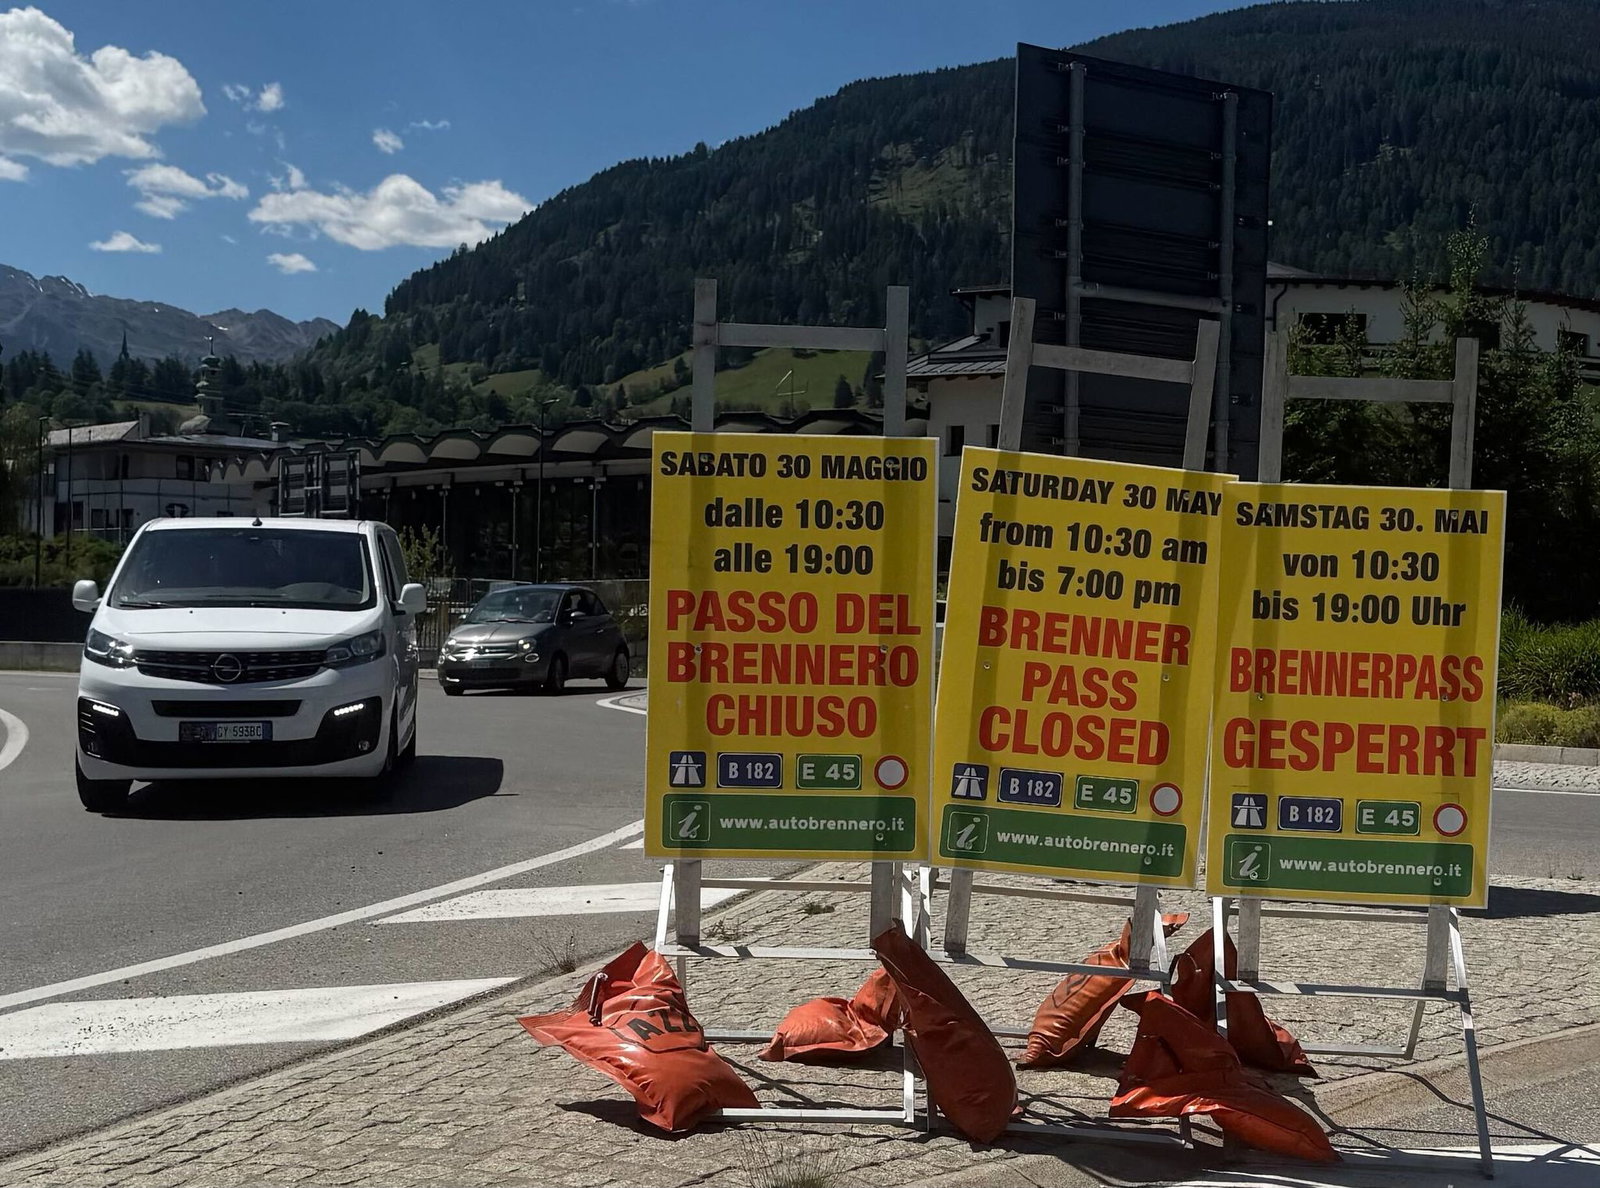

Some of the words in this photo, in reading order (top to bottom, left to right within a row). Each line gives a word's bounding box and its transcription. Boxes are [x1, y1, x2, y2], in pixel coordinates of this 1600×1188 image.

[661, 452, 766, 477] SABATO
[777, 455, 810, 478] 30
[822, 455, 927, 481] MAGGIO
[972, 468, 1114, 504] SATURDAY
[1123, 484, 1156, 509] 30
[1166, 488, 1221, 515] MAY
[705, 497, 782, 528] dalle
[796, 500, 884, 530] 10:30
[1237, 502, 1369, 530] SAMSTAG
[1380, 508, 1423, 531] 30.
[1435, 510, 1487, 533] MAI
[980, 513, 1053, 548] from
[1068, 523, 1151, 558] 10:30
[1161, 536, 1207, 564] am
[714, 543, 771, 573] alle
[786, 544, 873, 575] 19:00
[1283, 554, 1337, 577] von
[1353, 550, 1439, 581] 10:30
[998, 560, 1044, 592] bis
[1058, 566, 1123, 600] 7:00
[1134, 580, 1180, 608] pm
[667, 590, 818, 634] PASSO
[836, 594, 921, 636] DEL
[1253, 590, 1298, 620] bis
[1313, 593, 1399, 624] 19:00
[1412, 596, 1466, 626] Uhr
[979, 606, 1191, 666] BRENNER
[668, 642, 919, 687] BRENNERO
[1230, 648, 1483, 702] BRENNERPASS
[1021, 662, 1137, 712] PASS
[706, 694, 877, 738] CHIUSO
[979, 706, 1170, 766] CLOSED
[1223, 718, 1486, 777] GESPERRT
[729, 763, 738, 778] B
[747, 763, 773, 779] 182
[803, 764, 815, 779] E
[826, 764, 854, 780] 45
[1010, 778, 1019, 794] B
[1028, 780, 1053, 797] 182
[1081, 785, 1093, 801] E
[1103, 787, 1131, 804] 45
[720, 815, 905, 832] www.autobrennero.it
[1290, 806, 1299, 821] B
[1307, 807, 1333, 823] 182
[1363, 809, 1374, 824] E
[1385, 810, 1414, 826] 45
[996, 830, 1174, 857] www.autobrennero.it
[1280, 856, 1462, 877] www.autobrennero.it
